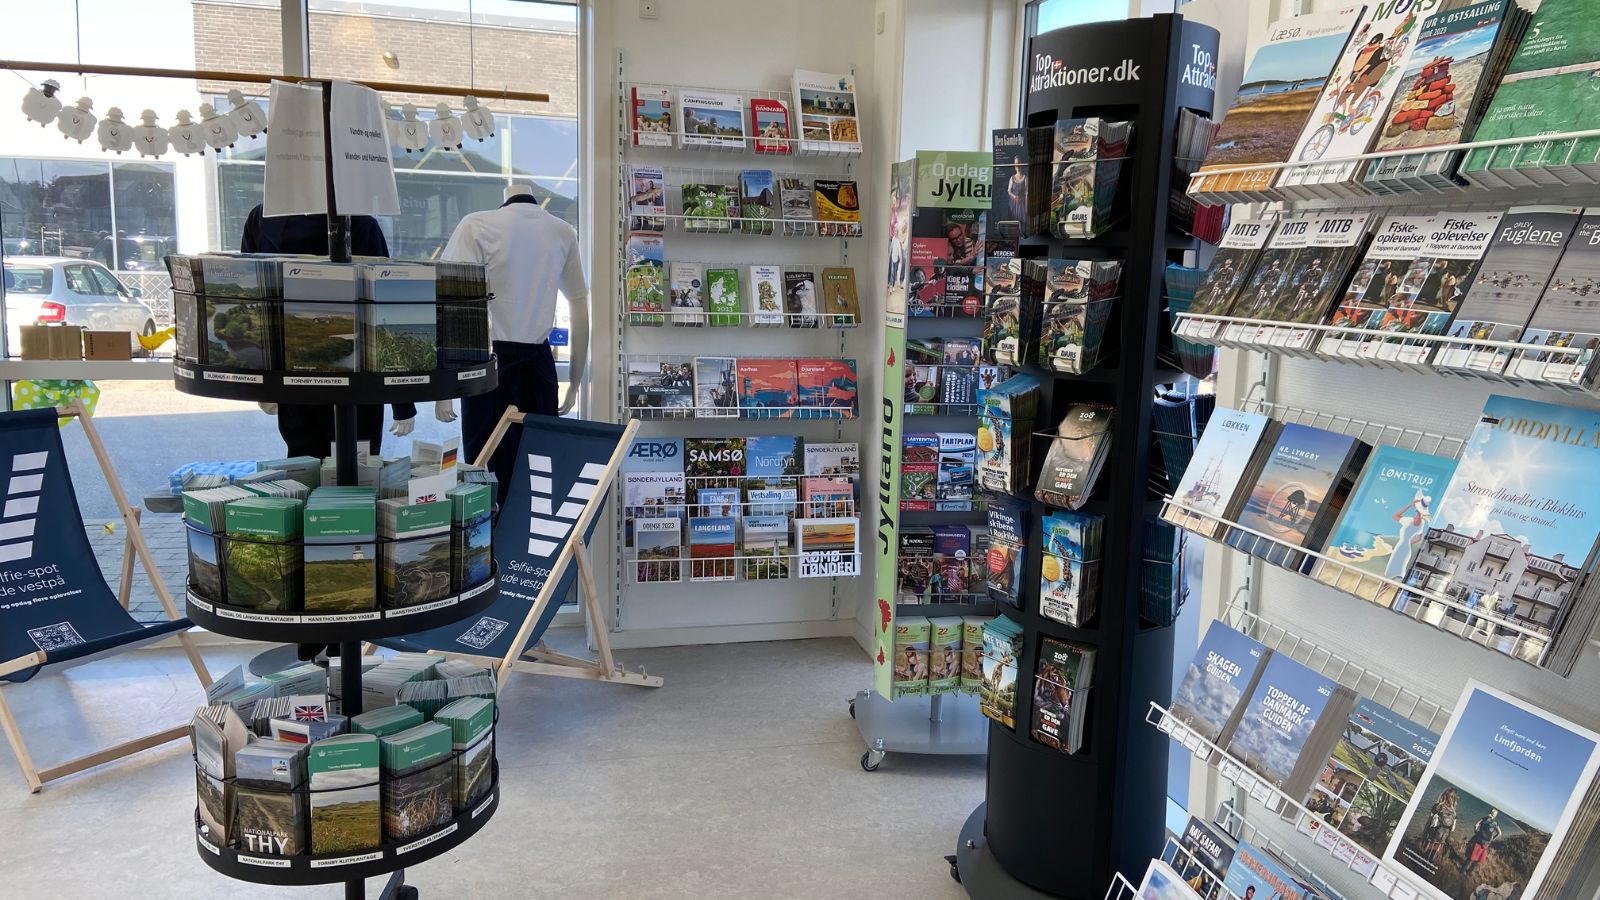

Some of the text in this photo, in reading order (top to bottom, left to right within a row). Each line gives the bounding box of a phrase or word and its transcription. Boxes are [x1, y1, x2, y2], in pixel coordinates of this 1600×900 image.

[1422, 1, 1501, 30] FUR & ØSTSALLING
[1434, 27, 1448, 36] 2023
[1529, 22, 1544, 39] 5
[1035, 54, 1052, 71] Top
[1192, 44, 1210, 68] Top
[1030, 59, 1141, 95] Attraktioner.dk
[932, 163, 991, 182] Opdag
[1244, 170, 1273, 183] 2023
[700, 190, 717, 198] Guide
[1231, 223, 1261, 237] MTB
[1280, 221, 1309, 236] MTB
[1319, 219, 1354, 233] MTB
[1388, 221, 1419, 233] Fiske-
[1443, 218, 1478, 231] Fiske-
[1430, 230, 1490, 243] oplevelser
[1499, 225, 1564, 245] Fuglene
[946, 274, 970, 285] Klog på
[946, 283, 969, 292] kloden!
[1221, 419, 1251, 433] LØKKEN
[942, 437, 974, 446] FARTPLAN
[628, 441, 678, 459] ÆRØ
[689, 448, 743, 463] SAMSØ
[806, 446, 857, 454] SØNDERJYLLAND
[1278, 445, 1320, 461] NR. LYNGBY
[755, 455, 795, 470] Nordfyn
[1380, 466, 1434, 487] LØNSTRUP
[1055, 482, 1073, 490] GAVE
[750, 490, 796, 501] Vestsalling 2023
[1464, 480, 1537, 509] Strandhotellet
[1540, 498, 1587, 520] Blokhus
[989, 510, 1015, 524] Vikinge-
[662, 521, 675, 530] 2023
[694, 524, 731, 532] LANGELAND
[989, 520, 1014, 533] skibene
[993, 529, 1019, 541] Roskilde
[802, 550, 840, 563] RØMØ
[0, 563, 60, 583] lfie-spot
[508, 559, 552, 578] Selfie-spo
[801, 561, 854, 576] TØNDER
[0, 574, 66, 597] de vestpå
[500, 573, 544, 592] ude vestp
[11, 599, 33, 608] opdag
[391, 605, 422, 616] HANSTHOLM
[897, 626, 909, 634] 22
[938, 628, 948, 636] 22
[966, 625, 978, 633] 22
[1206, 648, 1260, 678] SKAGEN 2023
[1206, 663, 1233, 684] GUIDEN
[1266, 684, 1331, 717] TOPPEN AF 2023
[1262, 695, 1305, 726] DANMARK
[1262, 708, 1295, 733] GUIDEN
[1041, 723, 1059, 736] GAVE
[1411, 742, 1433, 758] 2022
[1494, 733, 1542, 763] Limfjorden
[244, 828, 288, 837] NATIONALPARK
[244, 833, 289, 855] THY
[402, 838, 427, 852] TVERSTED
[1188, 824, 1222, 858] RAV SAFARI
[242, 857, 275, 866] NATIONALPARK
